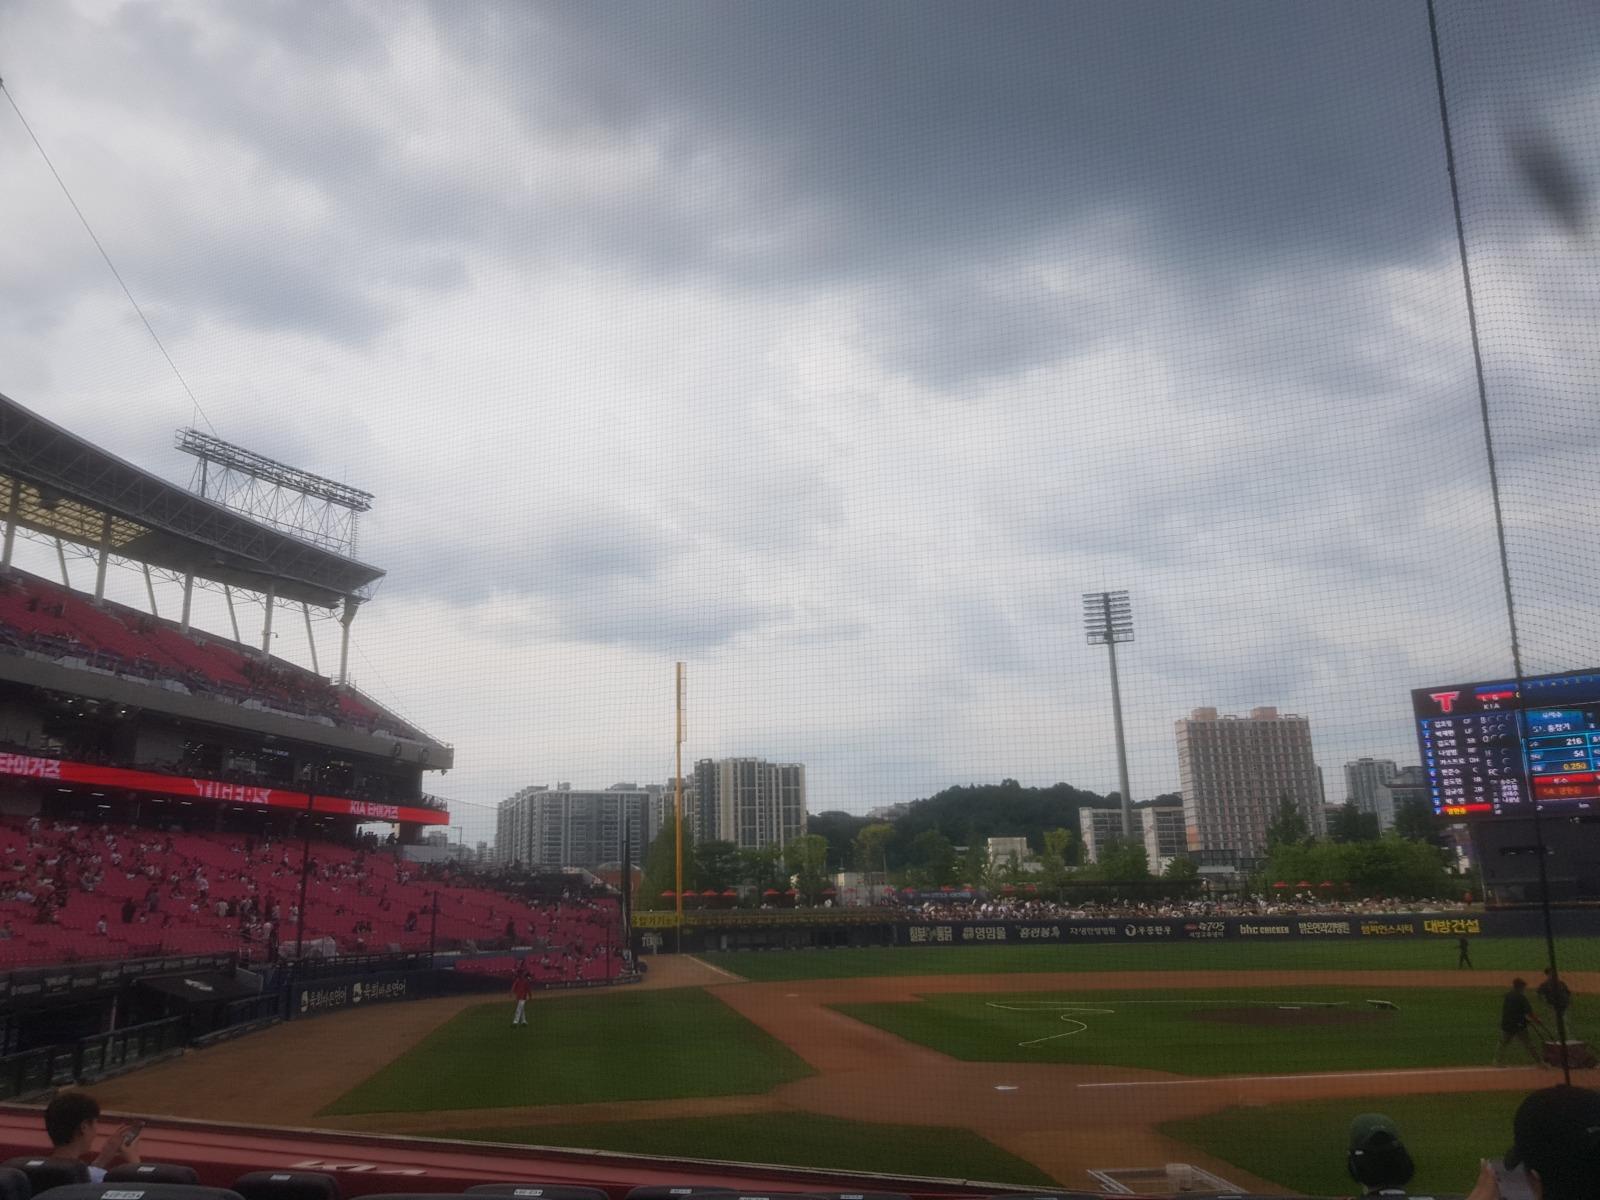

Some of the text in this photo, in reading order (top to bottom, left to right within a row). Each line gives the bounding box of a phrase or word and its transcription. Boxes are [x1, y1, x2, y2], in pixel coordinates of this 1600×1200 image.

[1573, 750, 1585, 758] 54
[1486, 759, 1493, 767] E
[1562, 762, 1588, 771] 0.250
[192, 779, 272, 804] TIGERS
[351, 801, 399, 819] KIA 타이거즈
[1240, 924, 1289, 935] bhc CHICKEN
[1298, 922, 1351, 935] 밝은안과21병원
[1423, 919, 1481, 934] 대방건설
